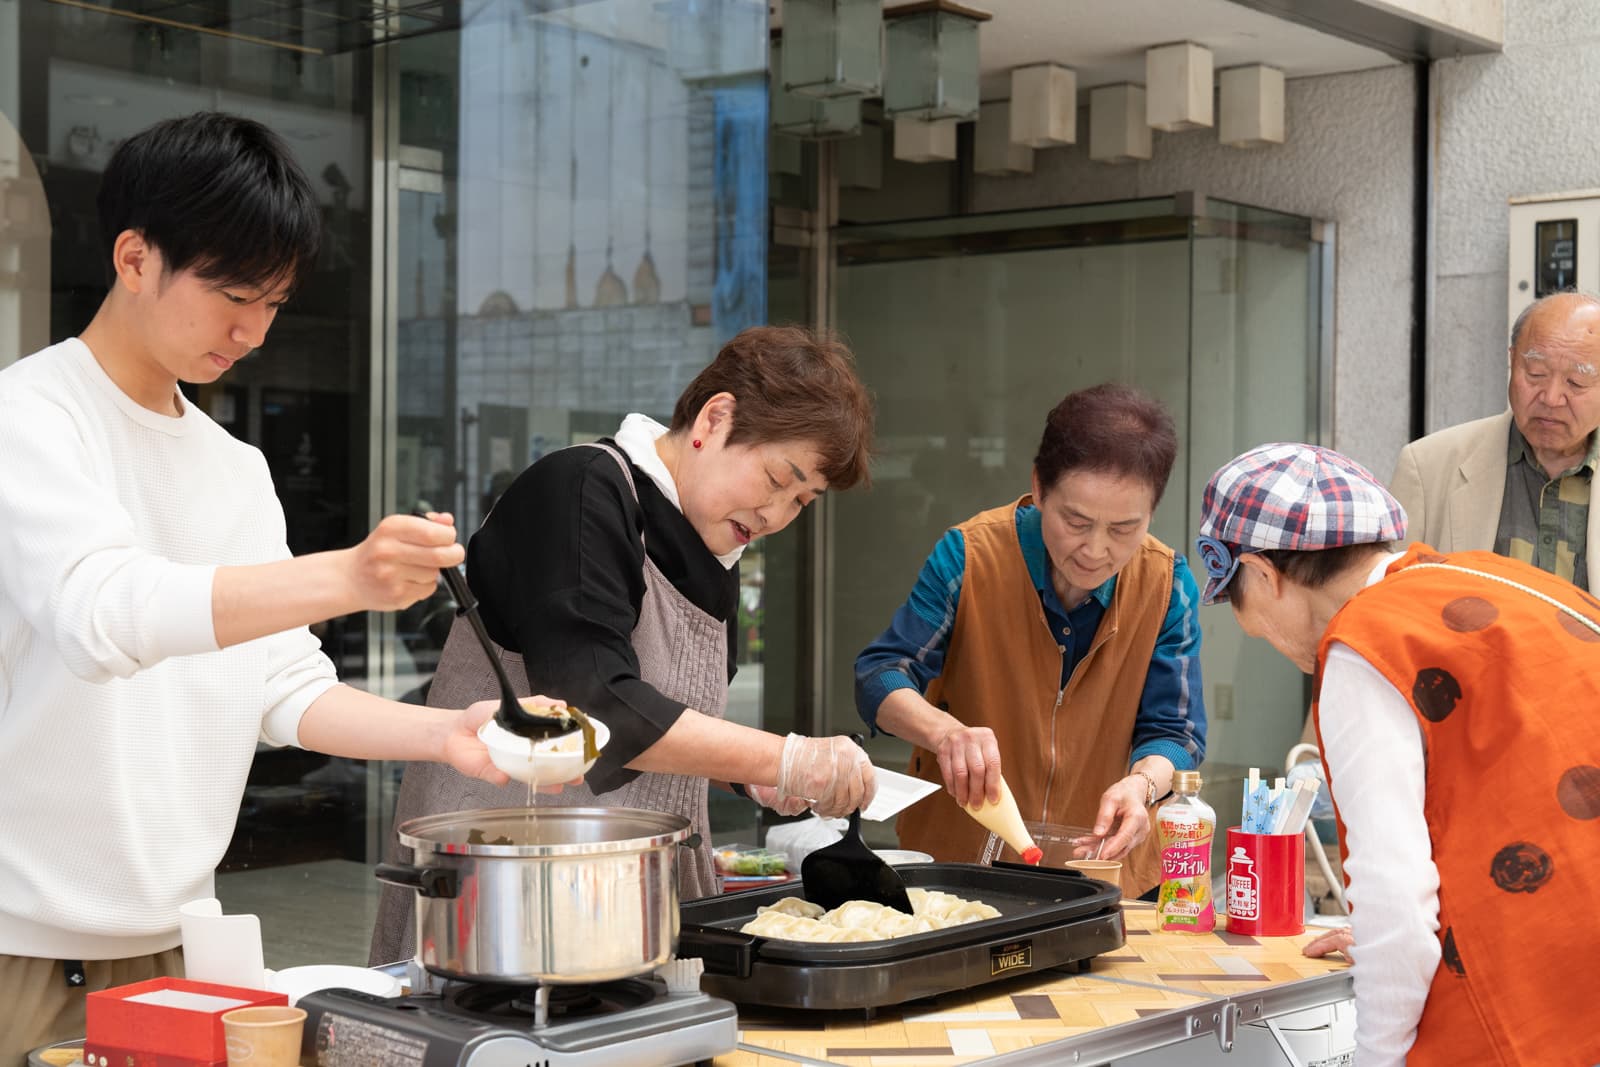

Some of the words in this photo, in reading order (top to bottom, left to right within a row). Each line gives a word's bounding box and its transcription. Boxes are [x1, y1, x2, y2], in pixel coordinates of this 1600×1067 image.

[1165, 852, 1200, 860] ヘルシー
[1231, 880, 1250, 889] COFFEE
[998, 952, 1025, 968] WIDE
